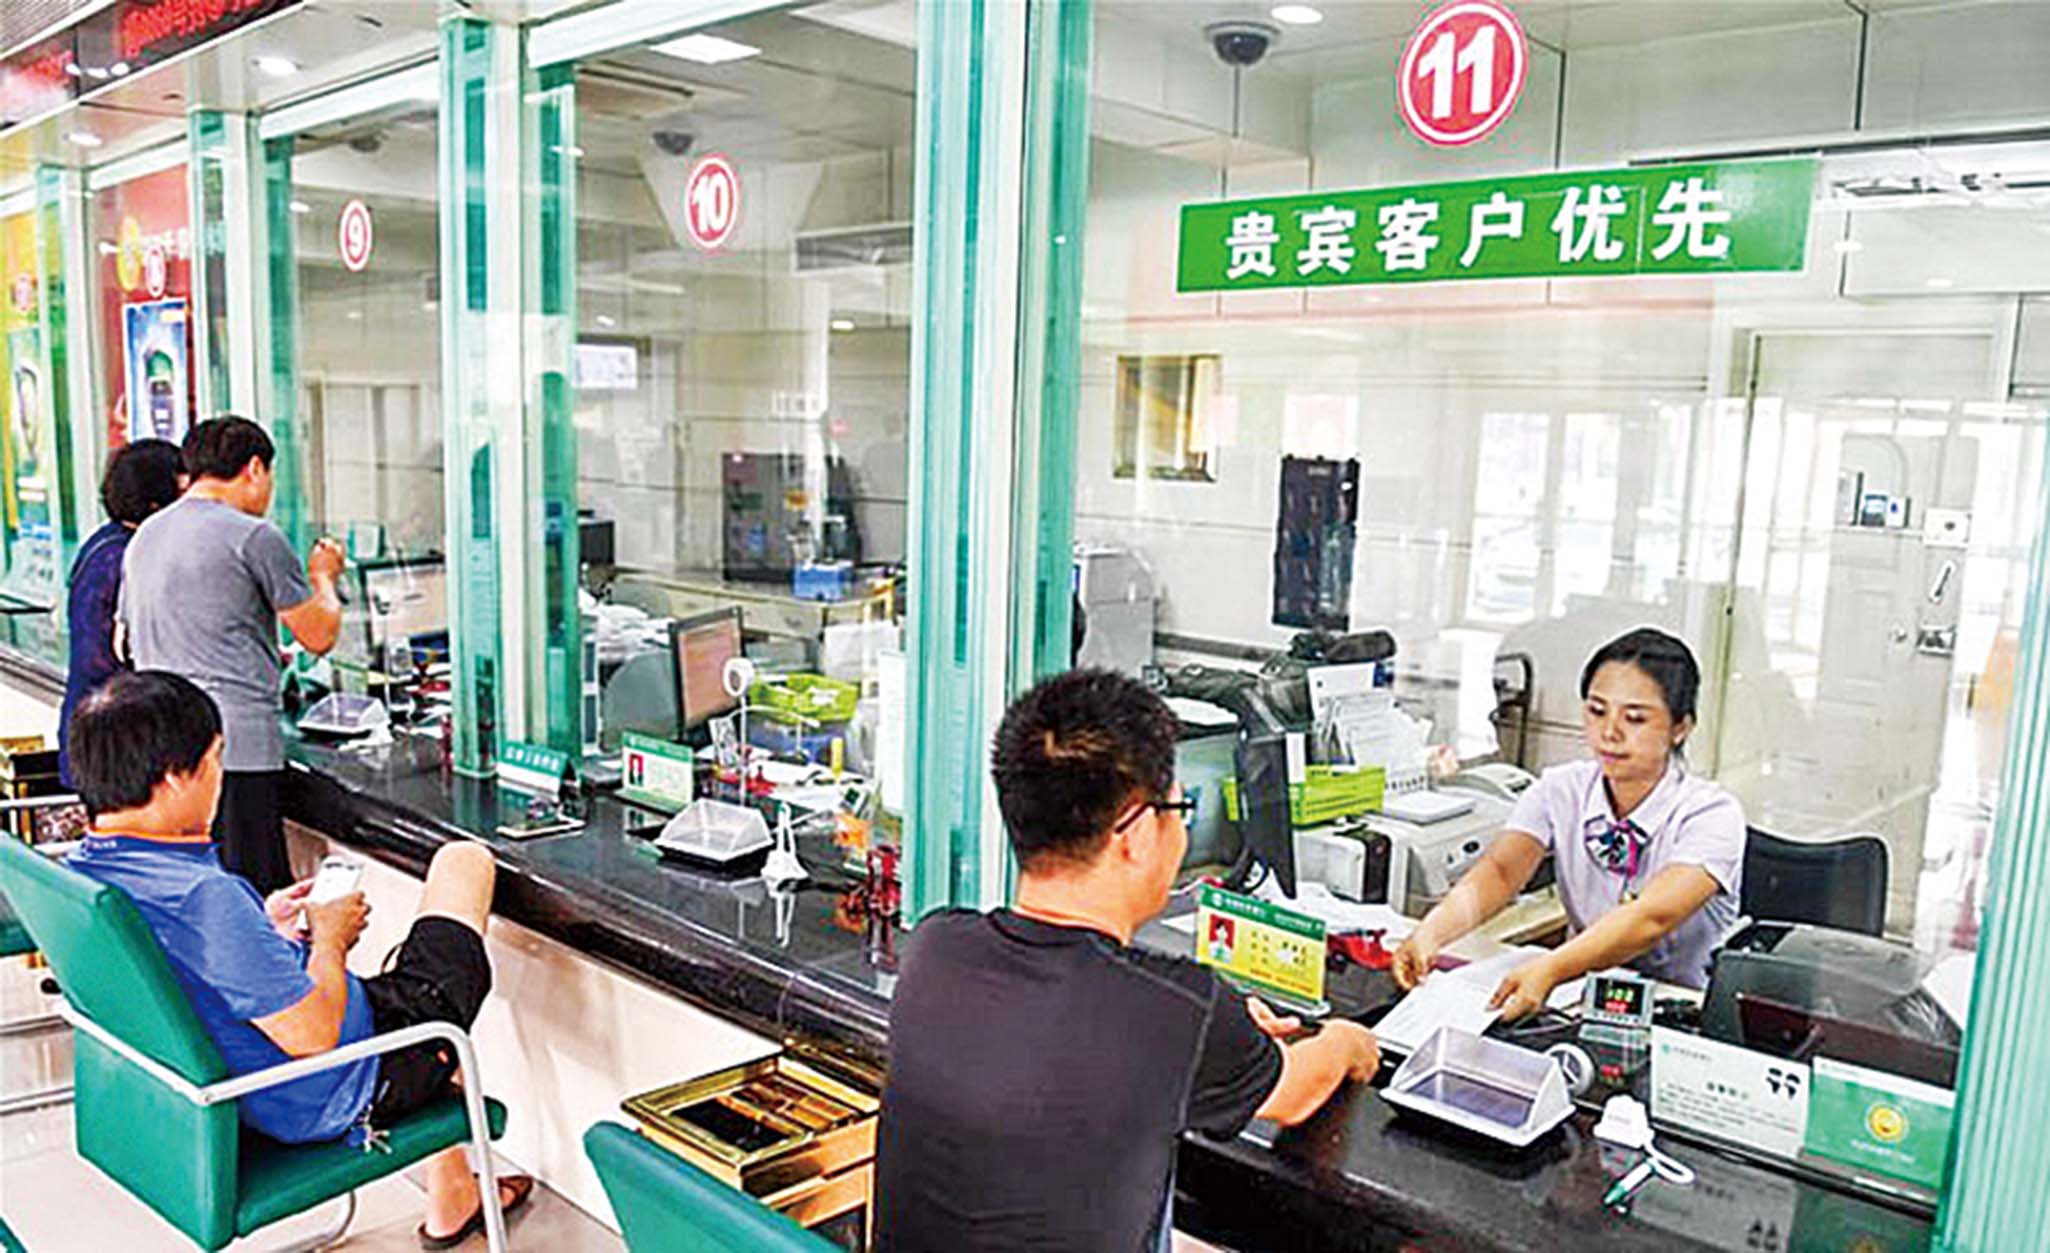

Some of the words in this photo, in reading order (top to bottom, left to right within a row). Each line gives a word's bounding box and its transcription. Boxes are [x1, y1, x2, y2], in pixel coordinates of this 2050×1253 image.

[1418, 24, 1496, 119] 11
[347, 214, 363, 258] 9
[692, 172, 729, 233] 10
[1225, 177, 1731, 280] 贵宾客户优先
